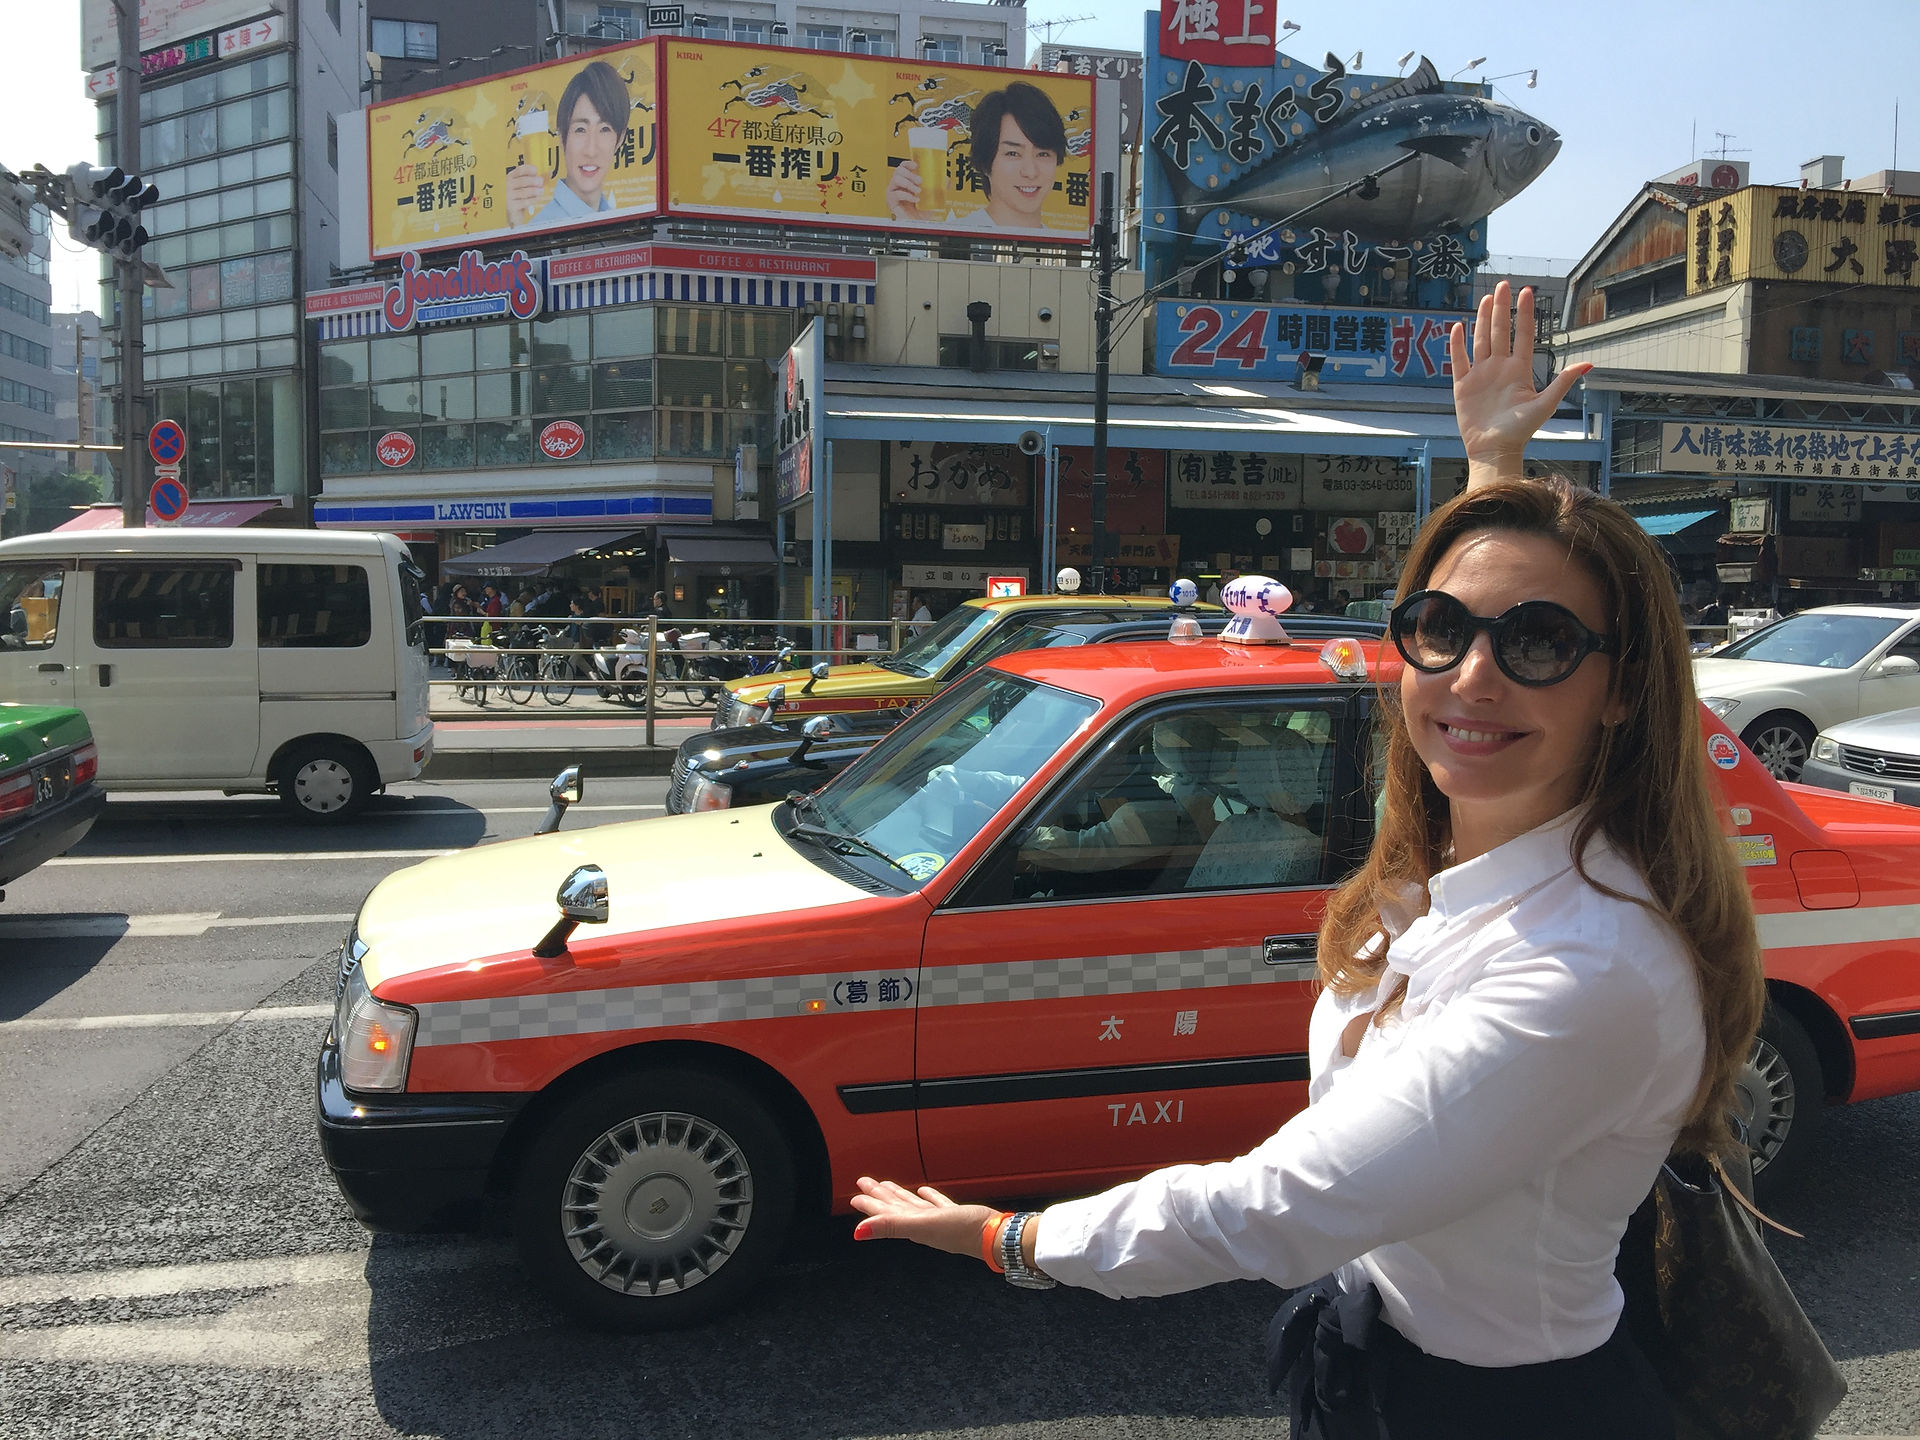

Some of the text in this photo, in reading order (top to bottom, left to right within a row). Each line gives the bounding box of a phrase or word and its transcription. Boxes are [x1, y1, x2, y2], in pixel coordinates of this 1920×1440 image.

[653, 11, 677, 22] JUN
[1168, 0, 1271, 46] 極上
[675, 50, 703, 62] KIRIN
[1074, 55, 1143, 79] 若どり・
[895, 71, 922, 82] KIRIN
[1152, 50, 1346, 170] 本まぐろ
[707, 117, 843, 146] 47都道府県の
[394, 152, 477, 185] 47都道府県の
[553, 252, 648, 275] COFFEE & RESTAURANT
[699, 253, 832, 273] COFFEE & RESTAURANT
[1295, 227, 1472, 280] すし一番
[308, 295, 332, 309] COFFEE
[340, 289, 383, 305] RESTAURANT
[1169, 305, 1271, 370] 24
[1277, 313, 1388, 354] 時間営業
[907, 454, 1013, 491] おかめ
[436, 502, 507, 522] LAWSON
[832, 976, 914, 1006] (葛飾)
[1107, 1100, 1185, 1127] TAXI
